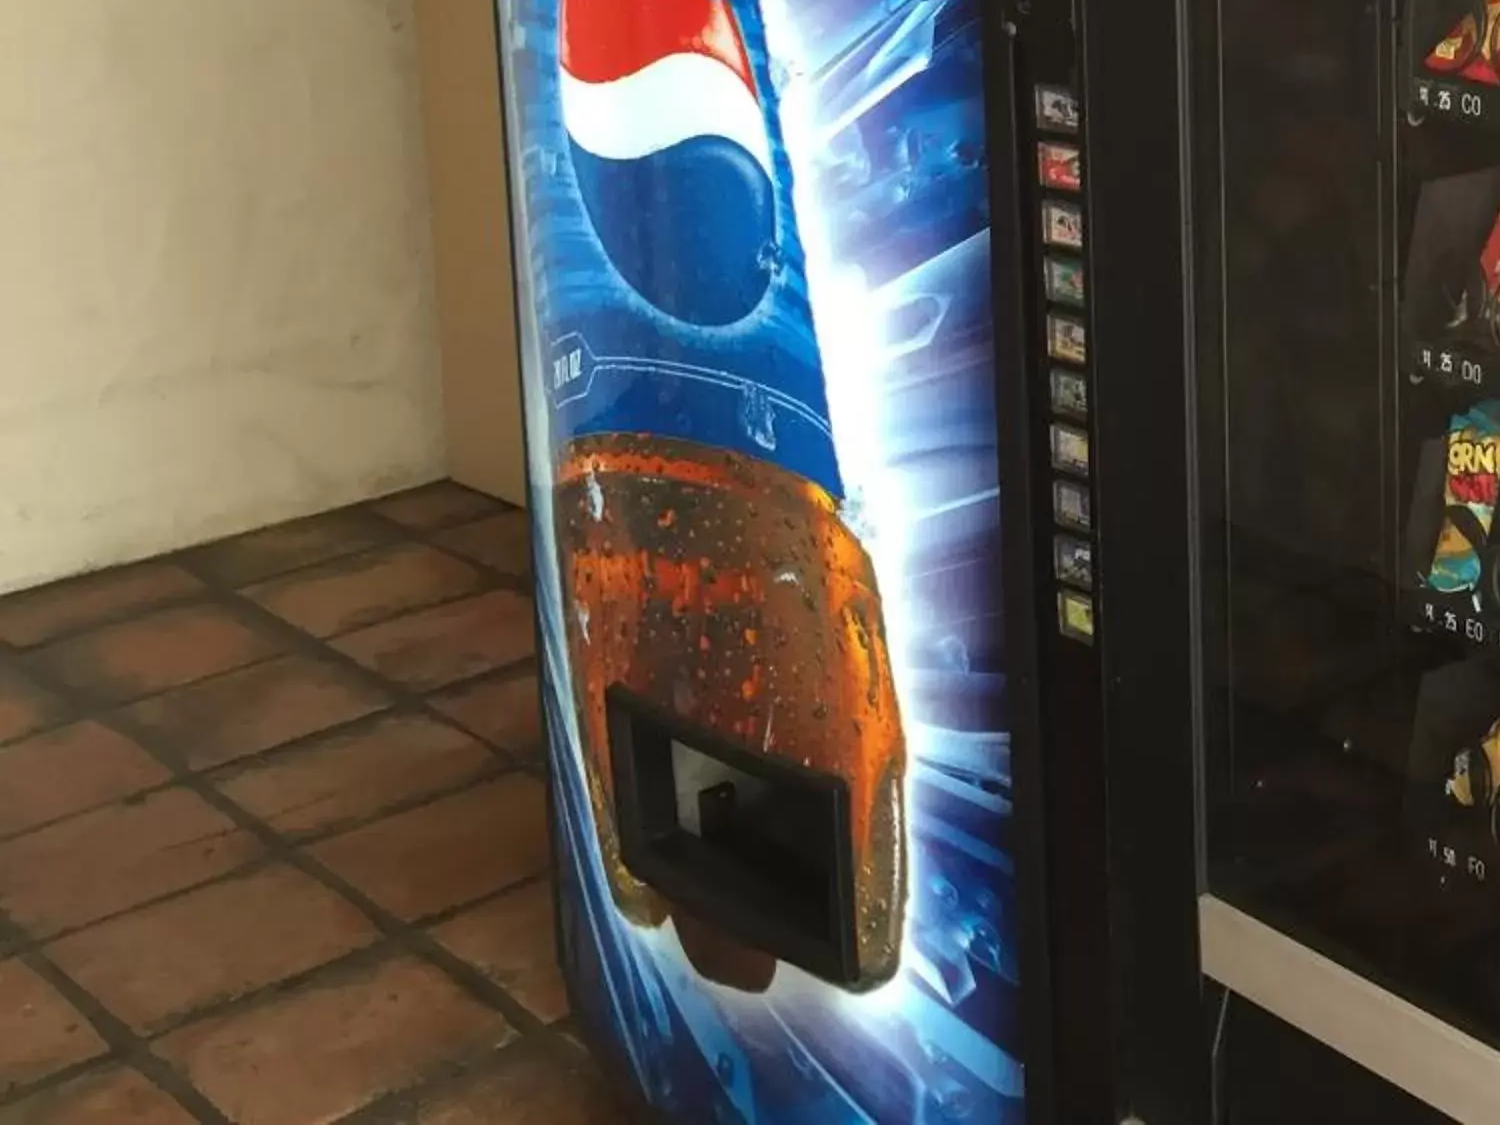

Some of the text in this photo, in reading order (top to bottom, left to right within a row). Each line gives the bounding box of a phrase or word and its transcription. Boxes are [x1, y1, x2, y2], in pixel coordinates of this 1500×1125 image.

[1461, 93, 1481, 116] C0
[1461, 360, 1482, 384] D0
[1465, 616, 1484, 642] E0
